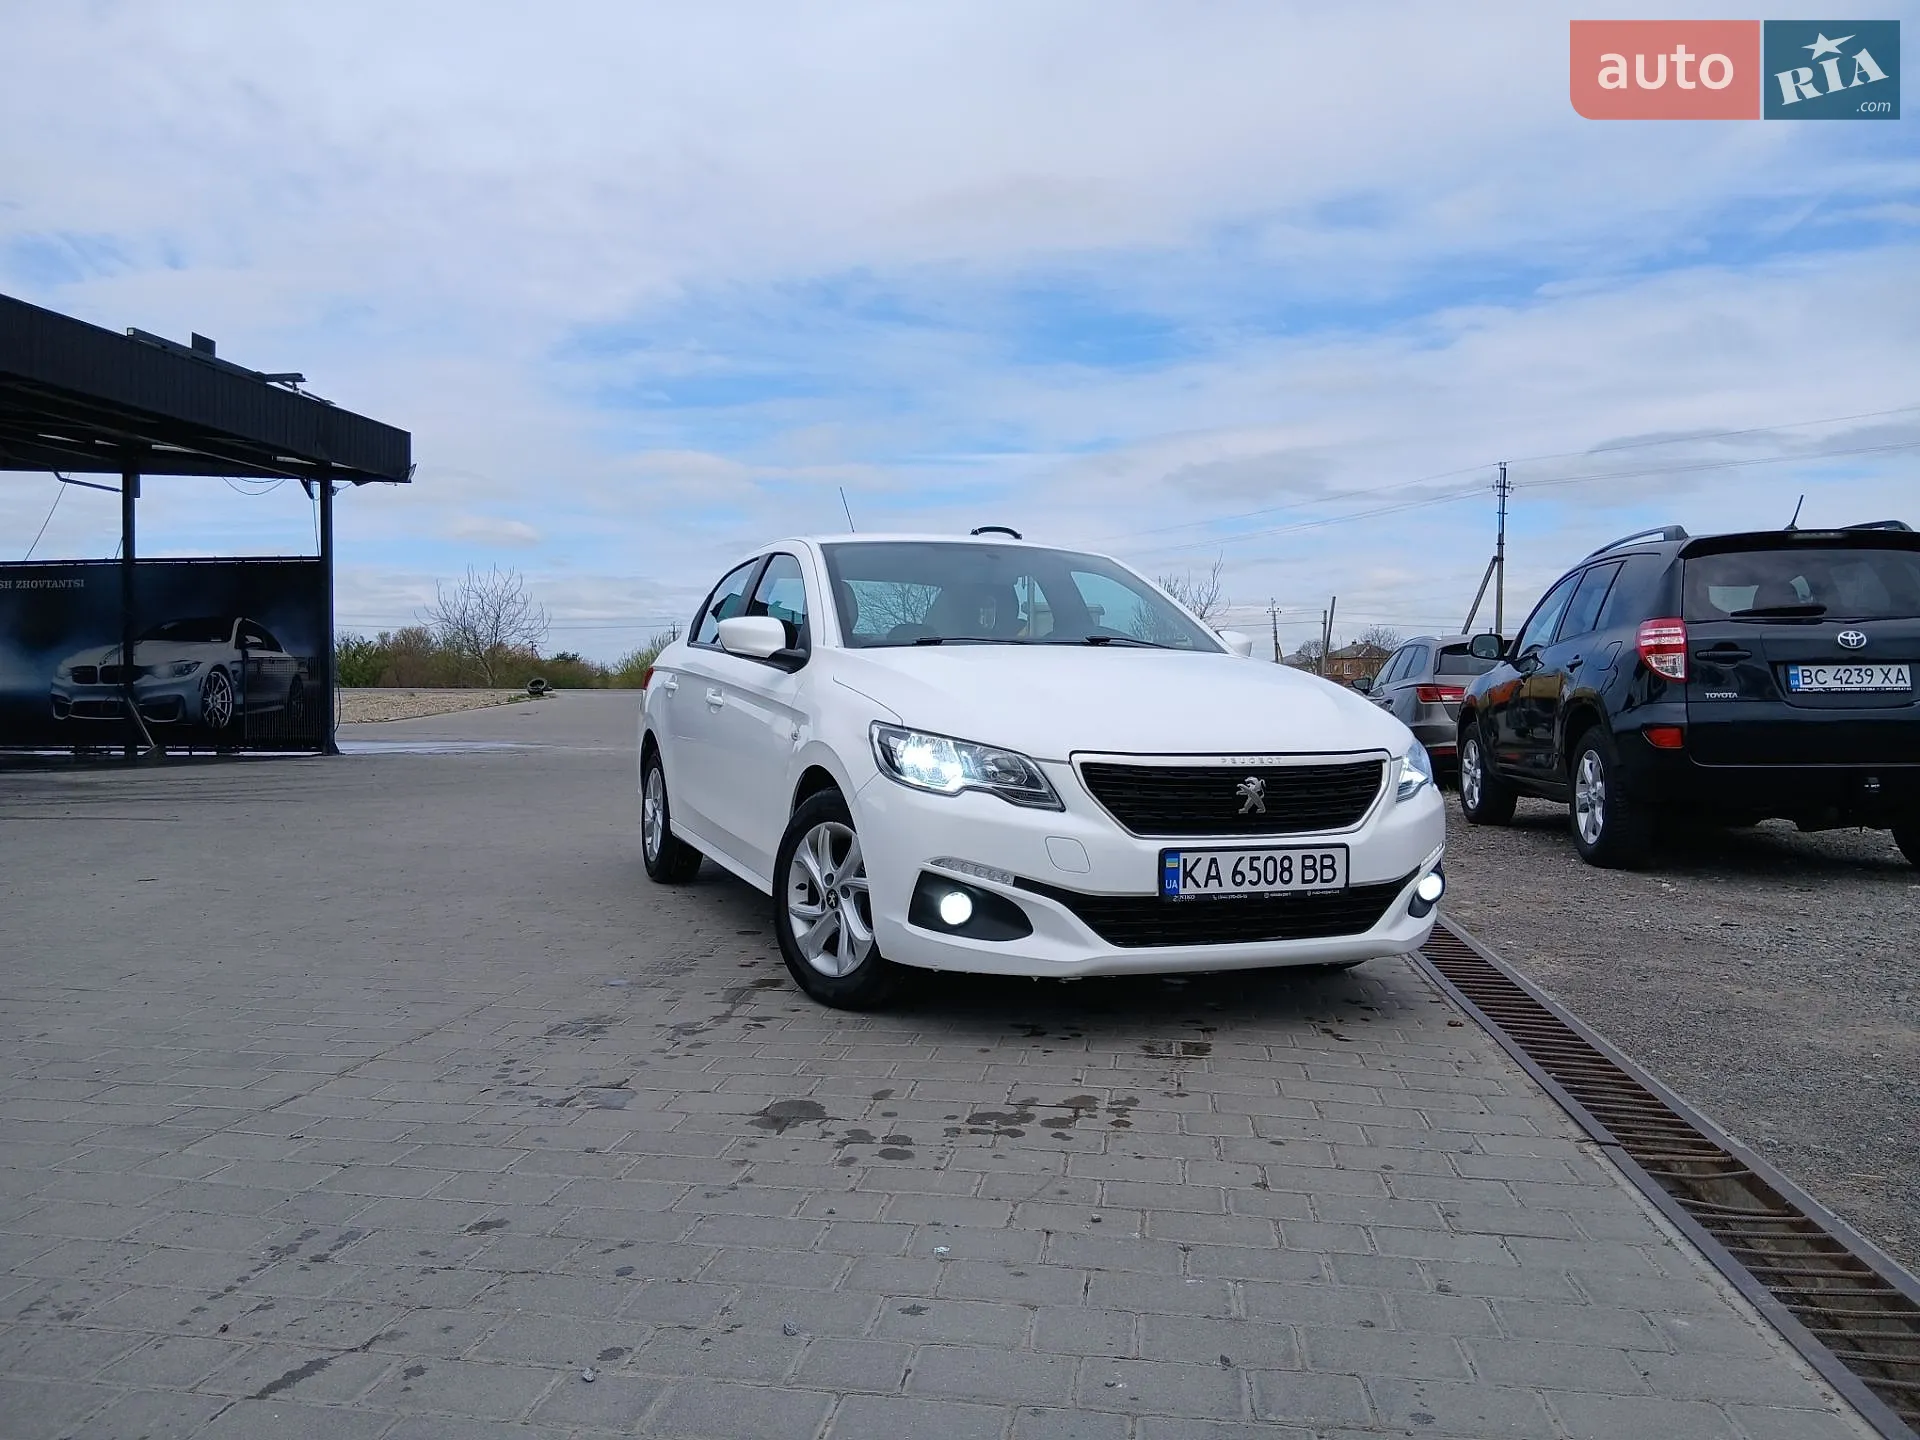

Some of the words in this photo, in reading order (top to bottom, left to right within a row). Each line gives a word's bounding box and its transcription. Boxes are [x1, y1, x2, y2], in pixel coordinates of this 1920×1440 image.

[15, 579, 84, 589] ZHOVTANTSI
[1801, 667, 1828, 685] BC
[1833, 667, 1874, 685] 4239
[1880, 667, 1907, 685] XA
[1221, 757, 1282, 765] PEUGEOT
[1182, 857, 1223, 889] KA
[1231, 855, 1293, 887] 6508
[1301, 854, 1337, 885] BB
[1165, 880, 1178, 890] UA
